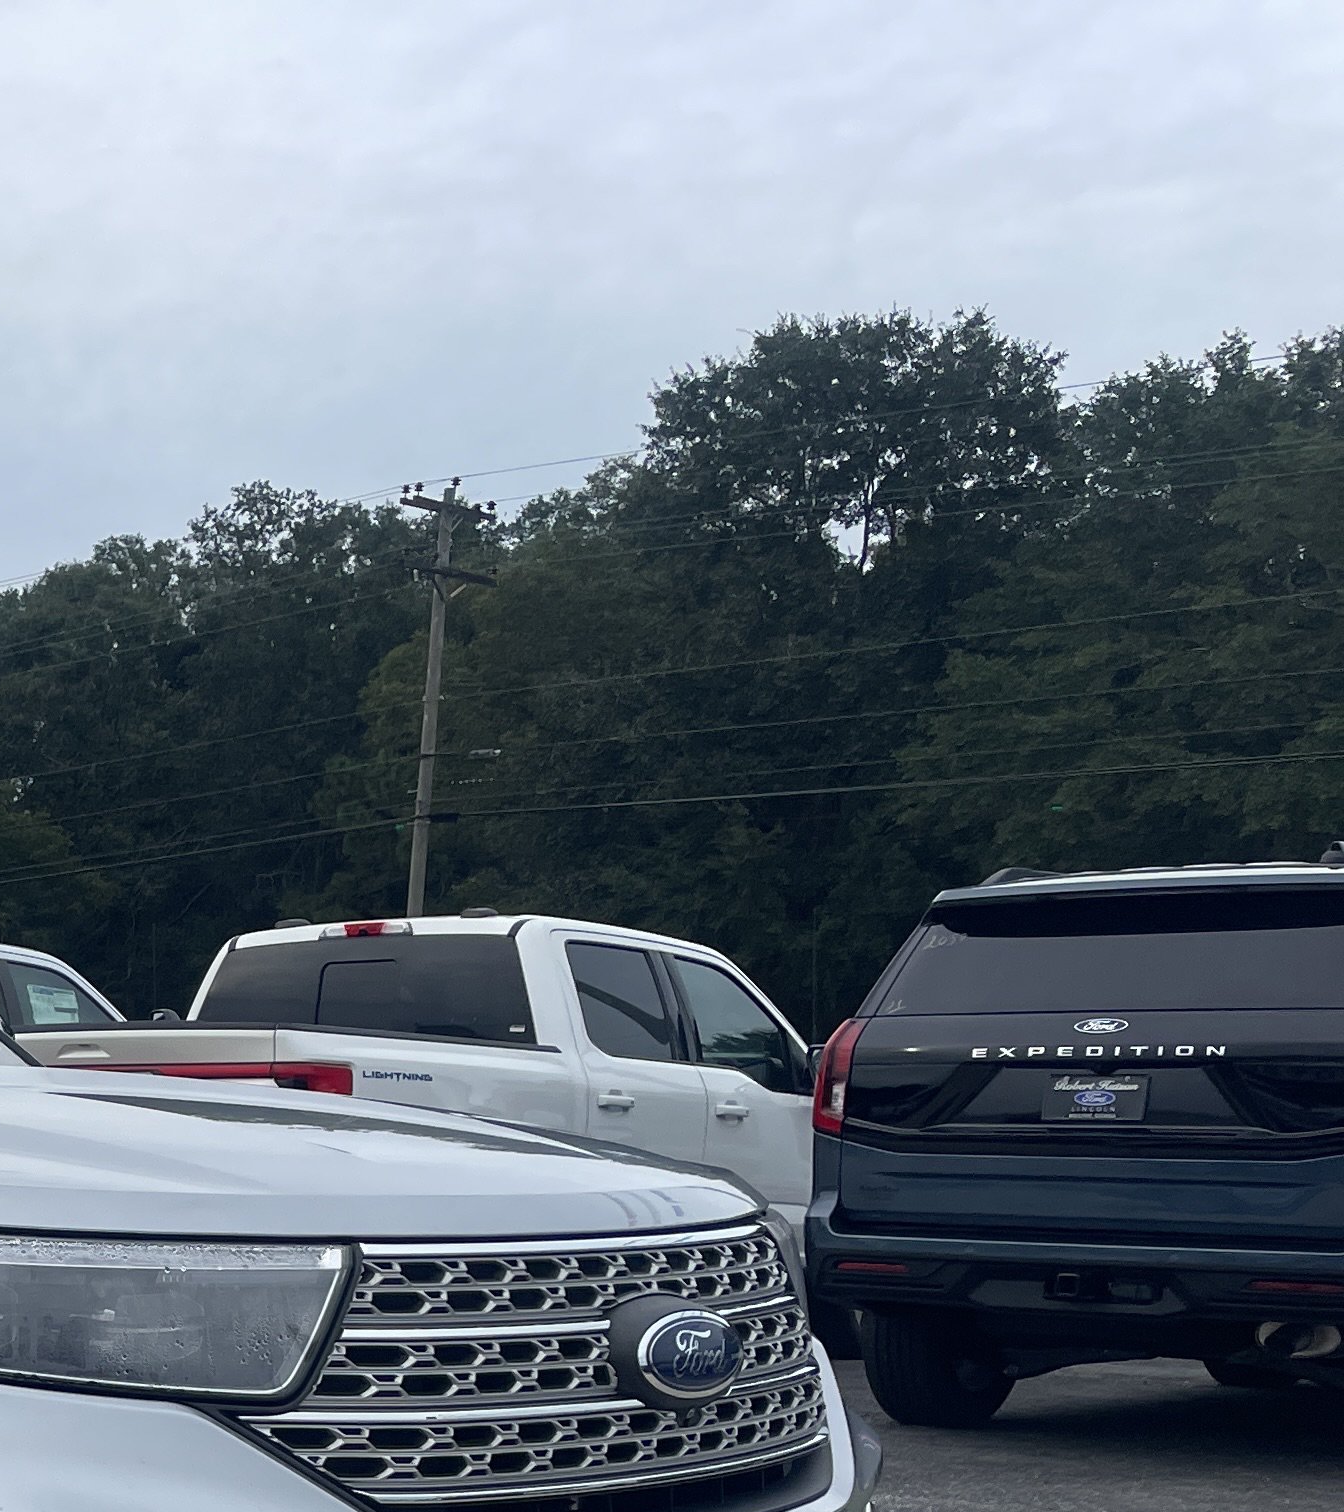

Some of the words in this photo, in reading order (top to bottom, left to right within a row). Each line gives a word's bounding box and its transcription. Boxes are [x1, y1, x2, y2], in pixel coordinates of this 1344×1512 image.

[1084, 1019, 1117, 1031] Ford
[971, 1045, 1226, 1059] EXPEDITION
[362, 1070, 433, 1082] LIGHTNING
[673, 1329, 726, 1378] Ford
